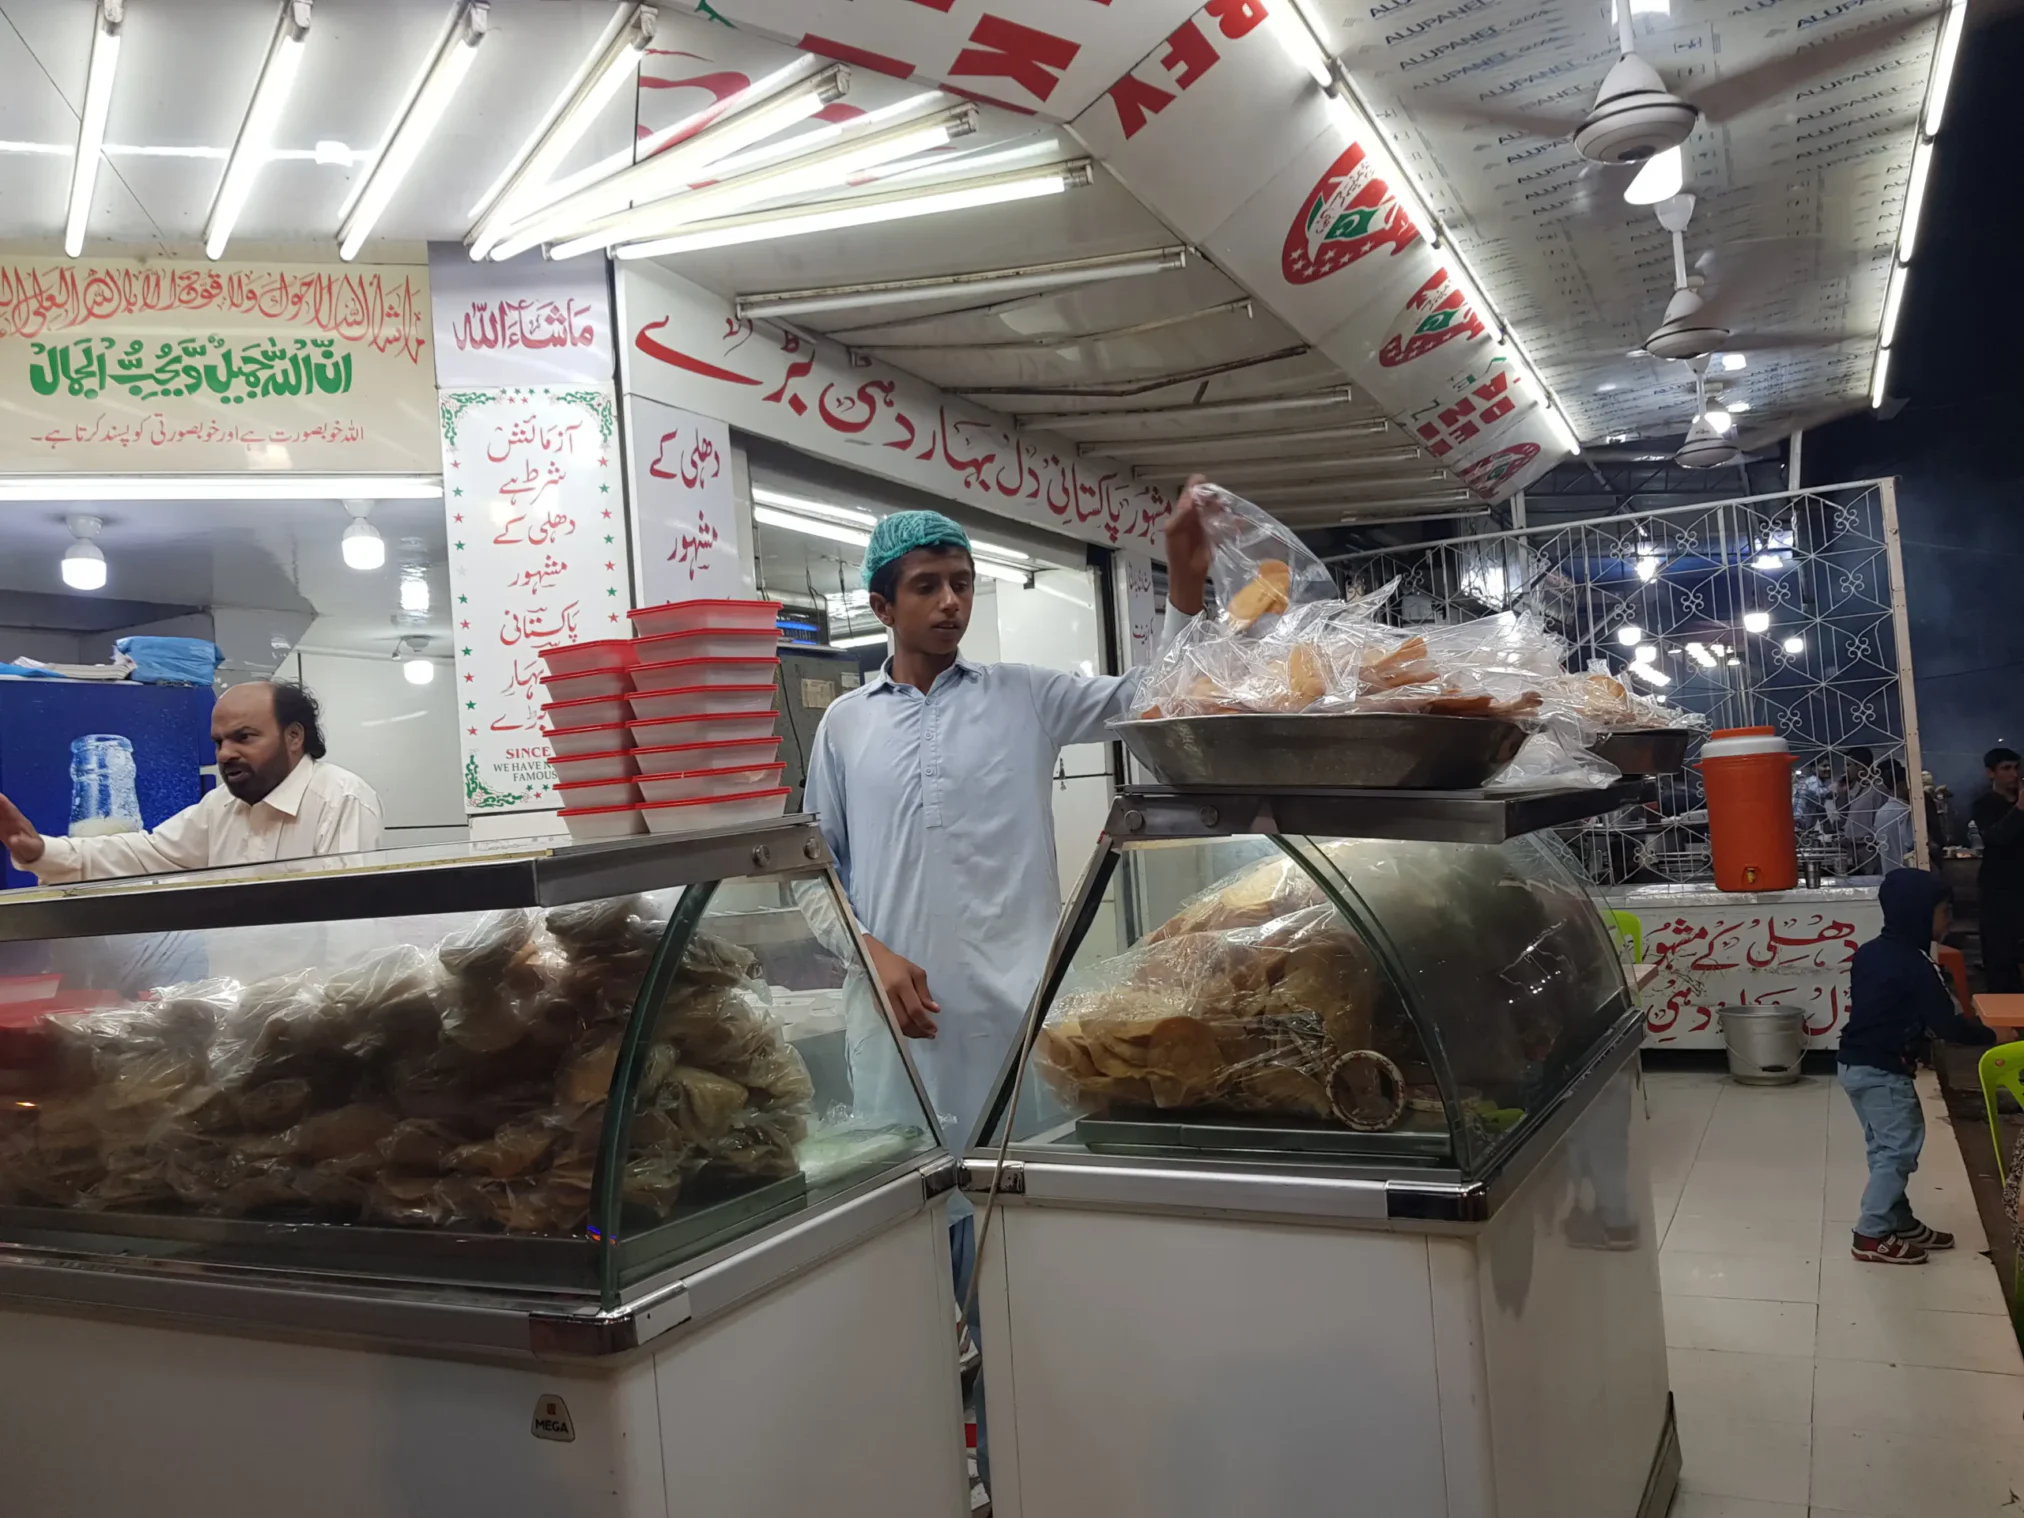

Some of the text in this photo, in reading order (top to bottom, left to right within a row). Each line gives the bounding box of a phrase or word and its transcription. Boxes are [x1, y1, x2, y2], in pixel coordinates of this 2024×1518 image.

[1400, 25, 1497, 70] ALUPANEL
[1796, 60, 1904, 100] ALUPANEL
[1796, 86, 1900, 124] ALUPANEL
[506, 746, 551, 759] SINCE
[494, 763, 510, 772] WE
[512, 761, 541, 771] HAVE
[514, 771, 558, 782] FAMOUS
[535, 1418, 569, 1433] MEGA
